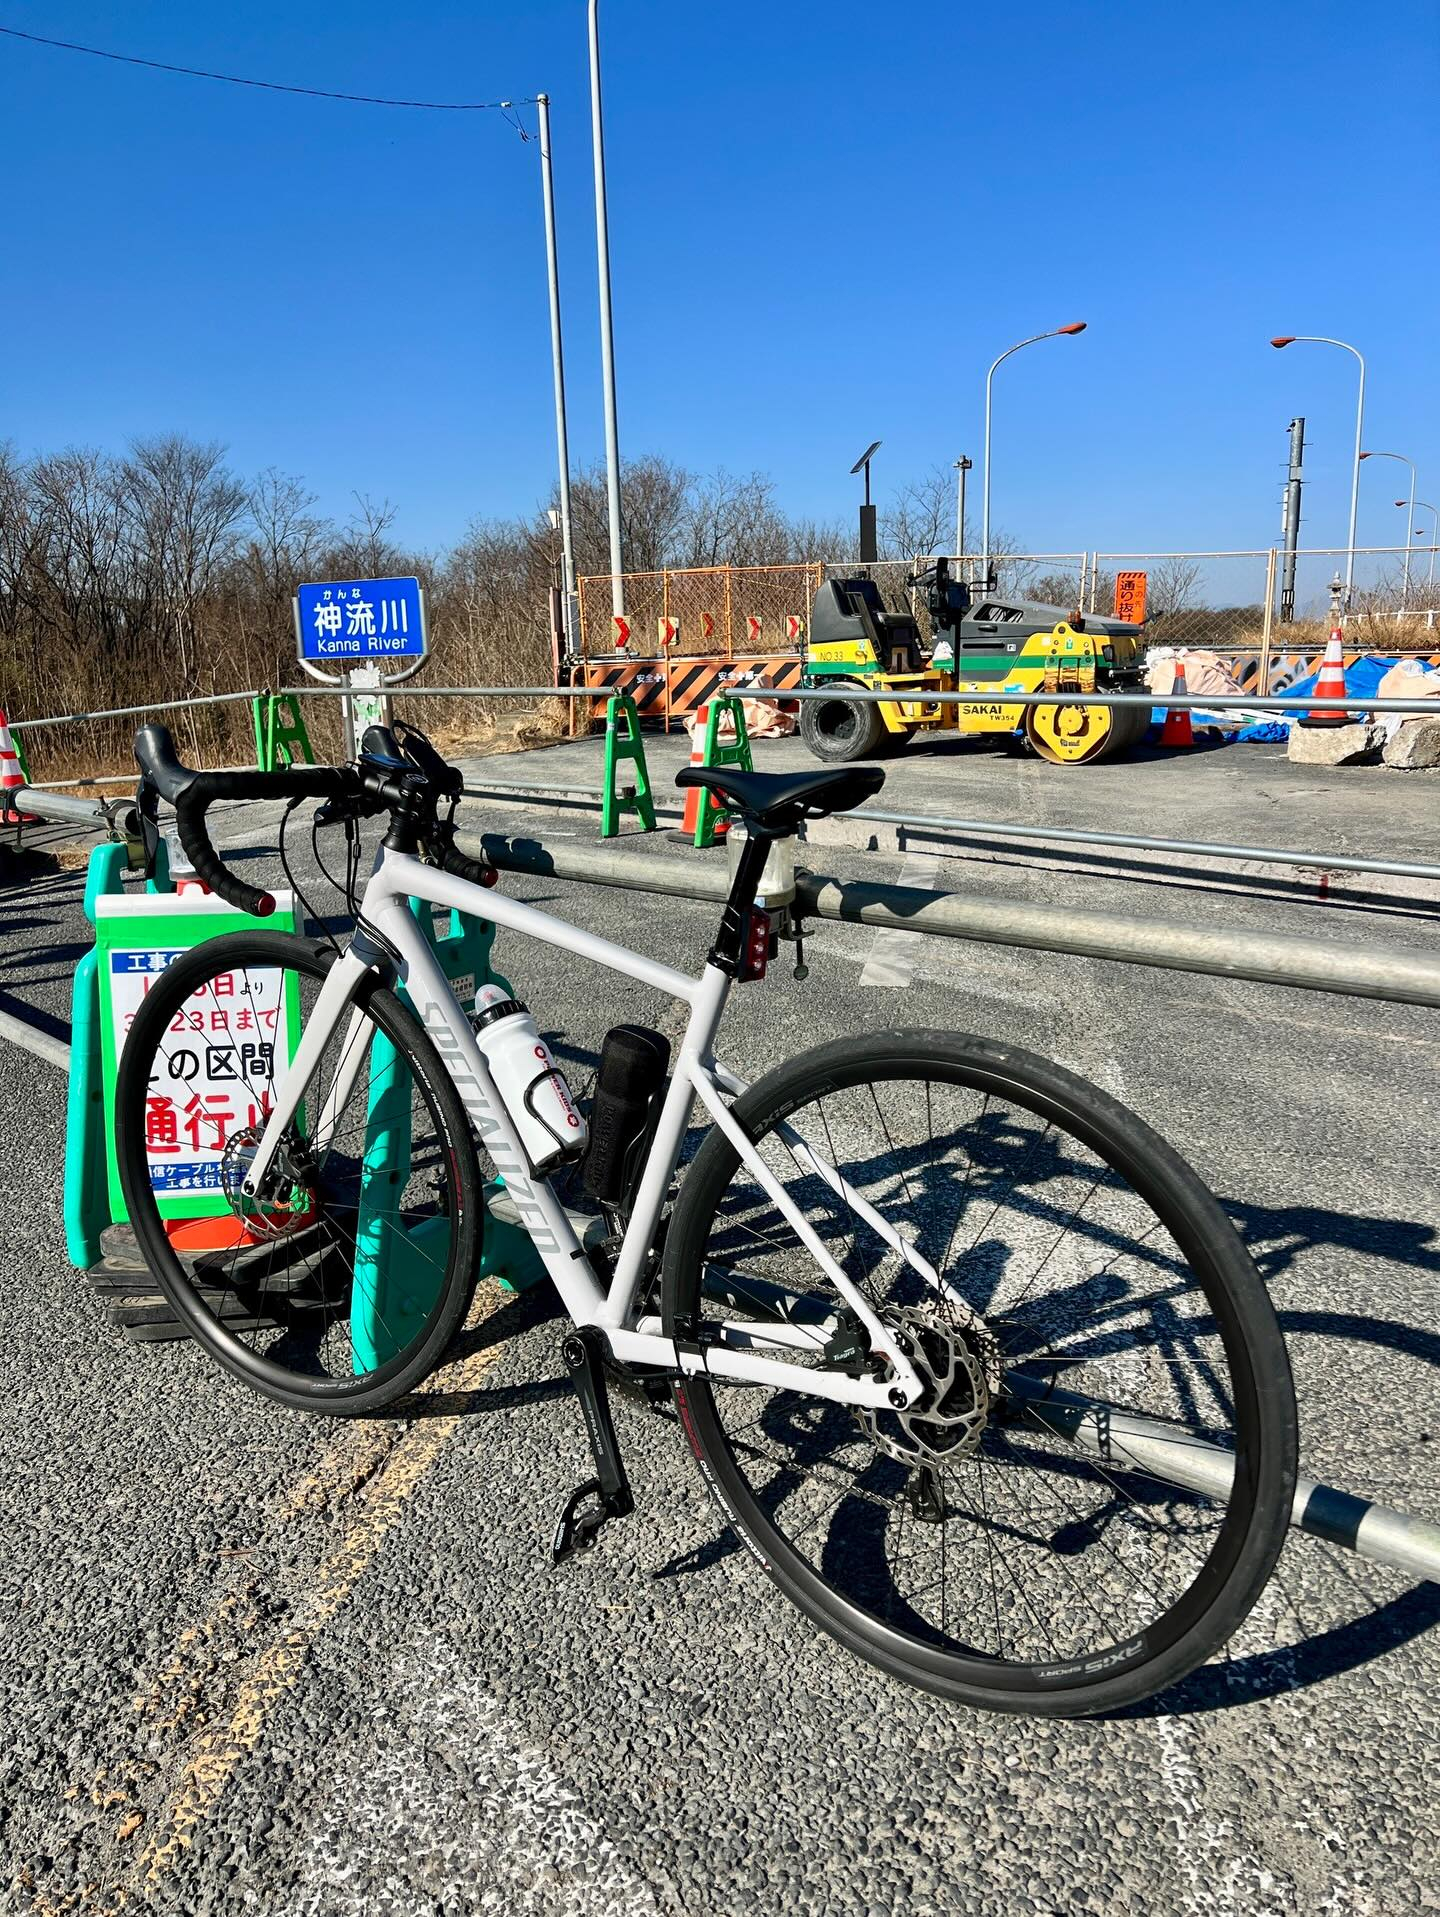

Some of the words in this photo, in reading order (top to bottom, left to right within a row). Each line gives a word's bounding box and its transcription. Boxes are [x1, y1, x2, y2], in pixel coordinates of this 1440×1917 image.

[323, 588, 360, 600] かんな
[313, 599, 408, 637] 神流川
[317, 639, 360, 653] Kanna
[368, 636, 408, 650] River
[834, 651, 843, 661] 33
[962, 705, 1002, 715] SAKAI
[423, 1001, 562, 1254] SPECIALIZED
[588, 1410, 604, 1455] PRAXIS
[699, 1460, 714, 1482] PRO
[712, 1483, 737, 1521] RUBINO
[736, 1522, 769, 1566] vittoria
